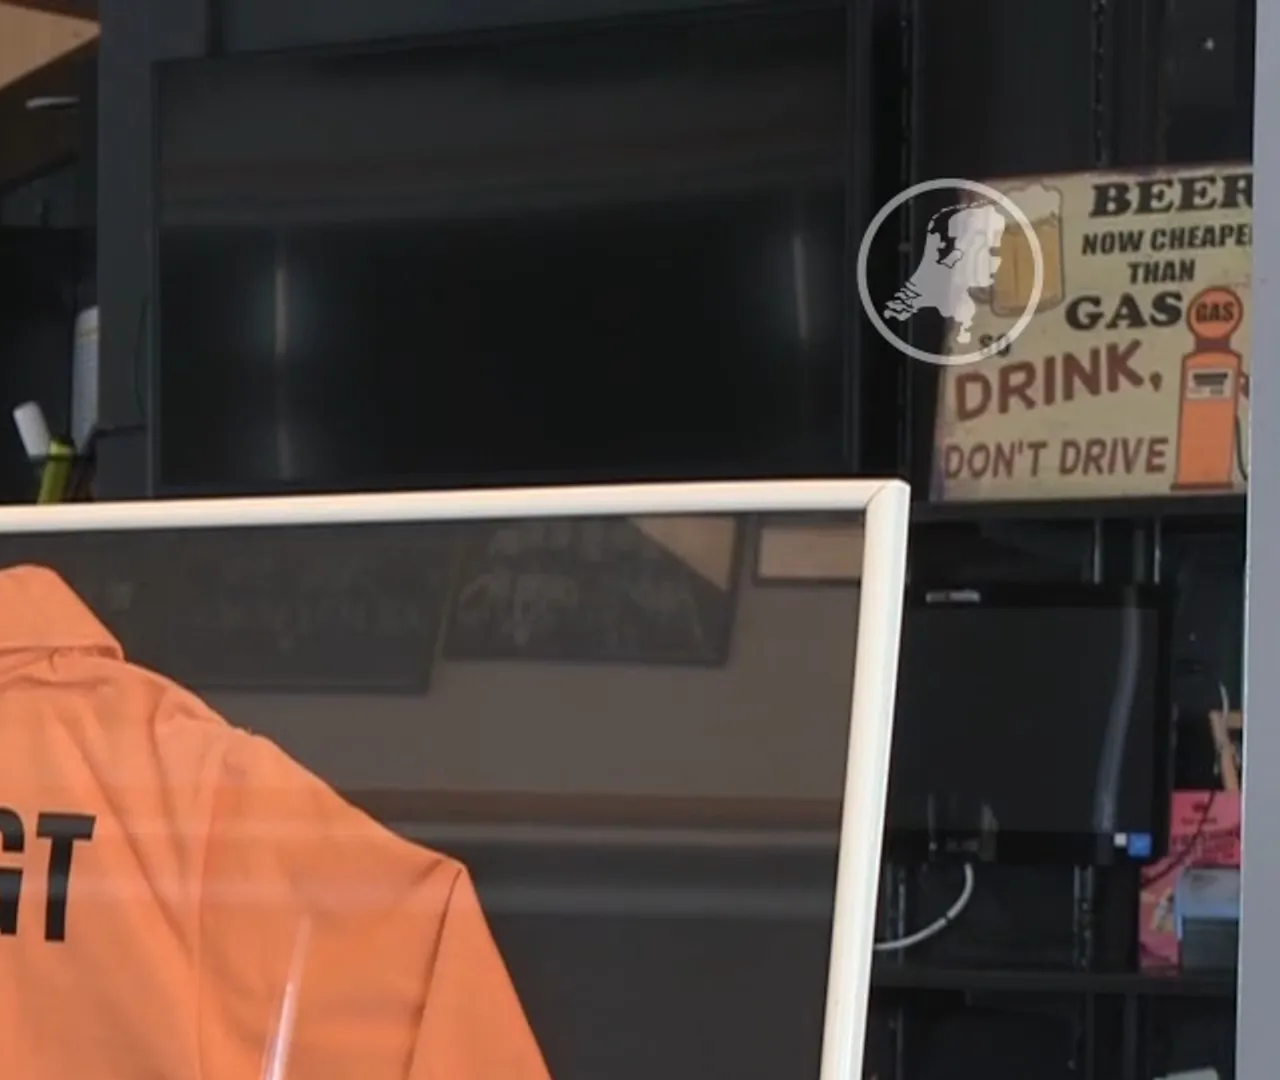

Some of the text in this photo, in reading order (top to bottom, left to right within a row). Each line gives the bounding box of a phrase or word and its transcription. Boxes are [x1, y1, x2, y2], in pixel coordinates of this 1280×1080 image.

[1082, 222, 1253, 256] NOW CHEAPE
[1128, 259, 1196, 285] THAN
[1065, 290, 1184, 331] GAS
[1195, 301, 1234, 323] GAS
[955, 340, 1164, 421] DRINK,
[944, 437, 1169, 480] DON'T DRIVE
